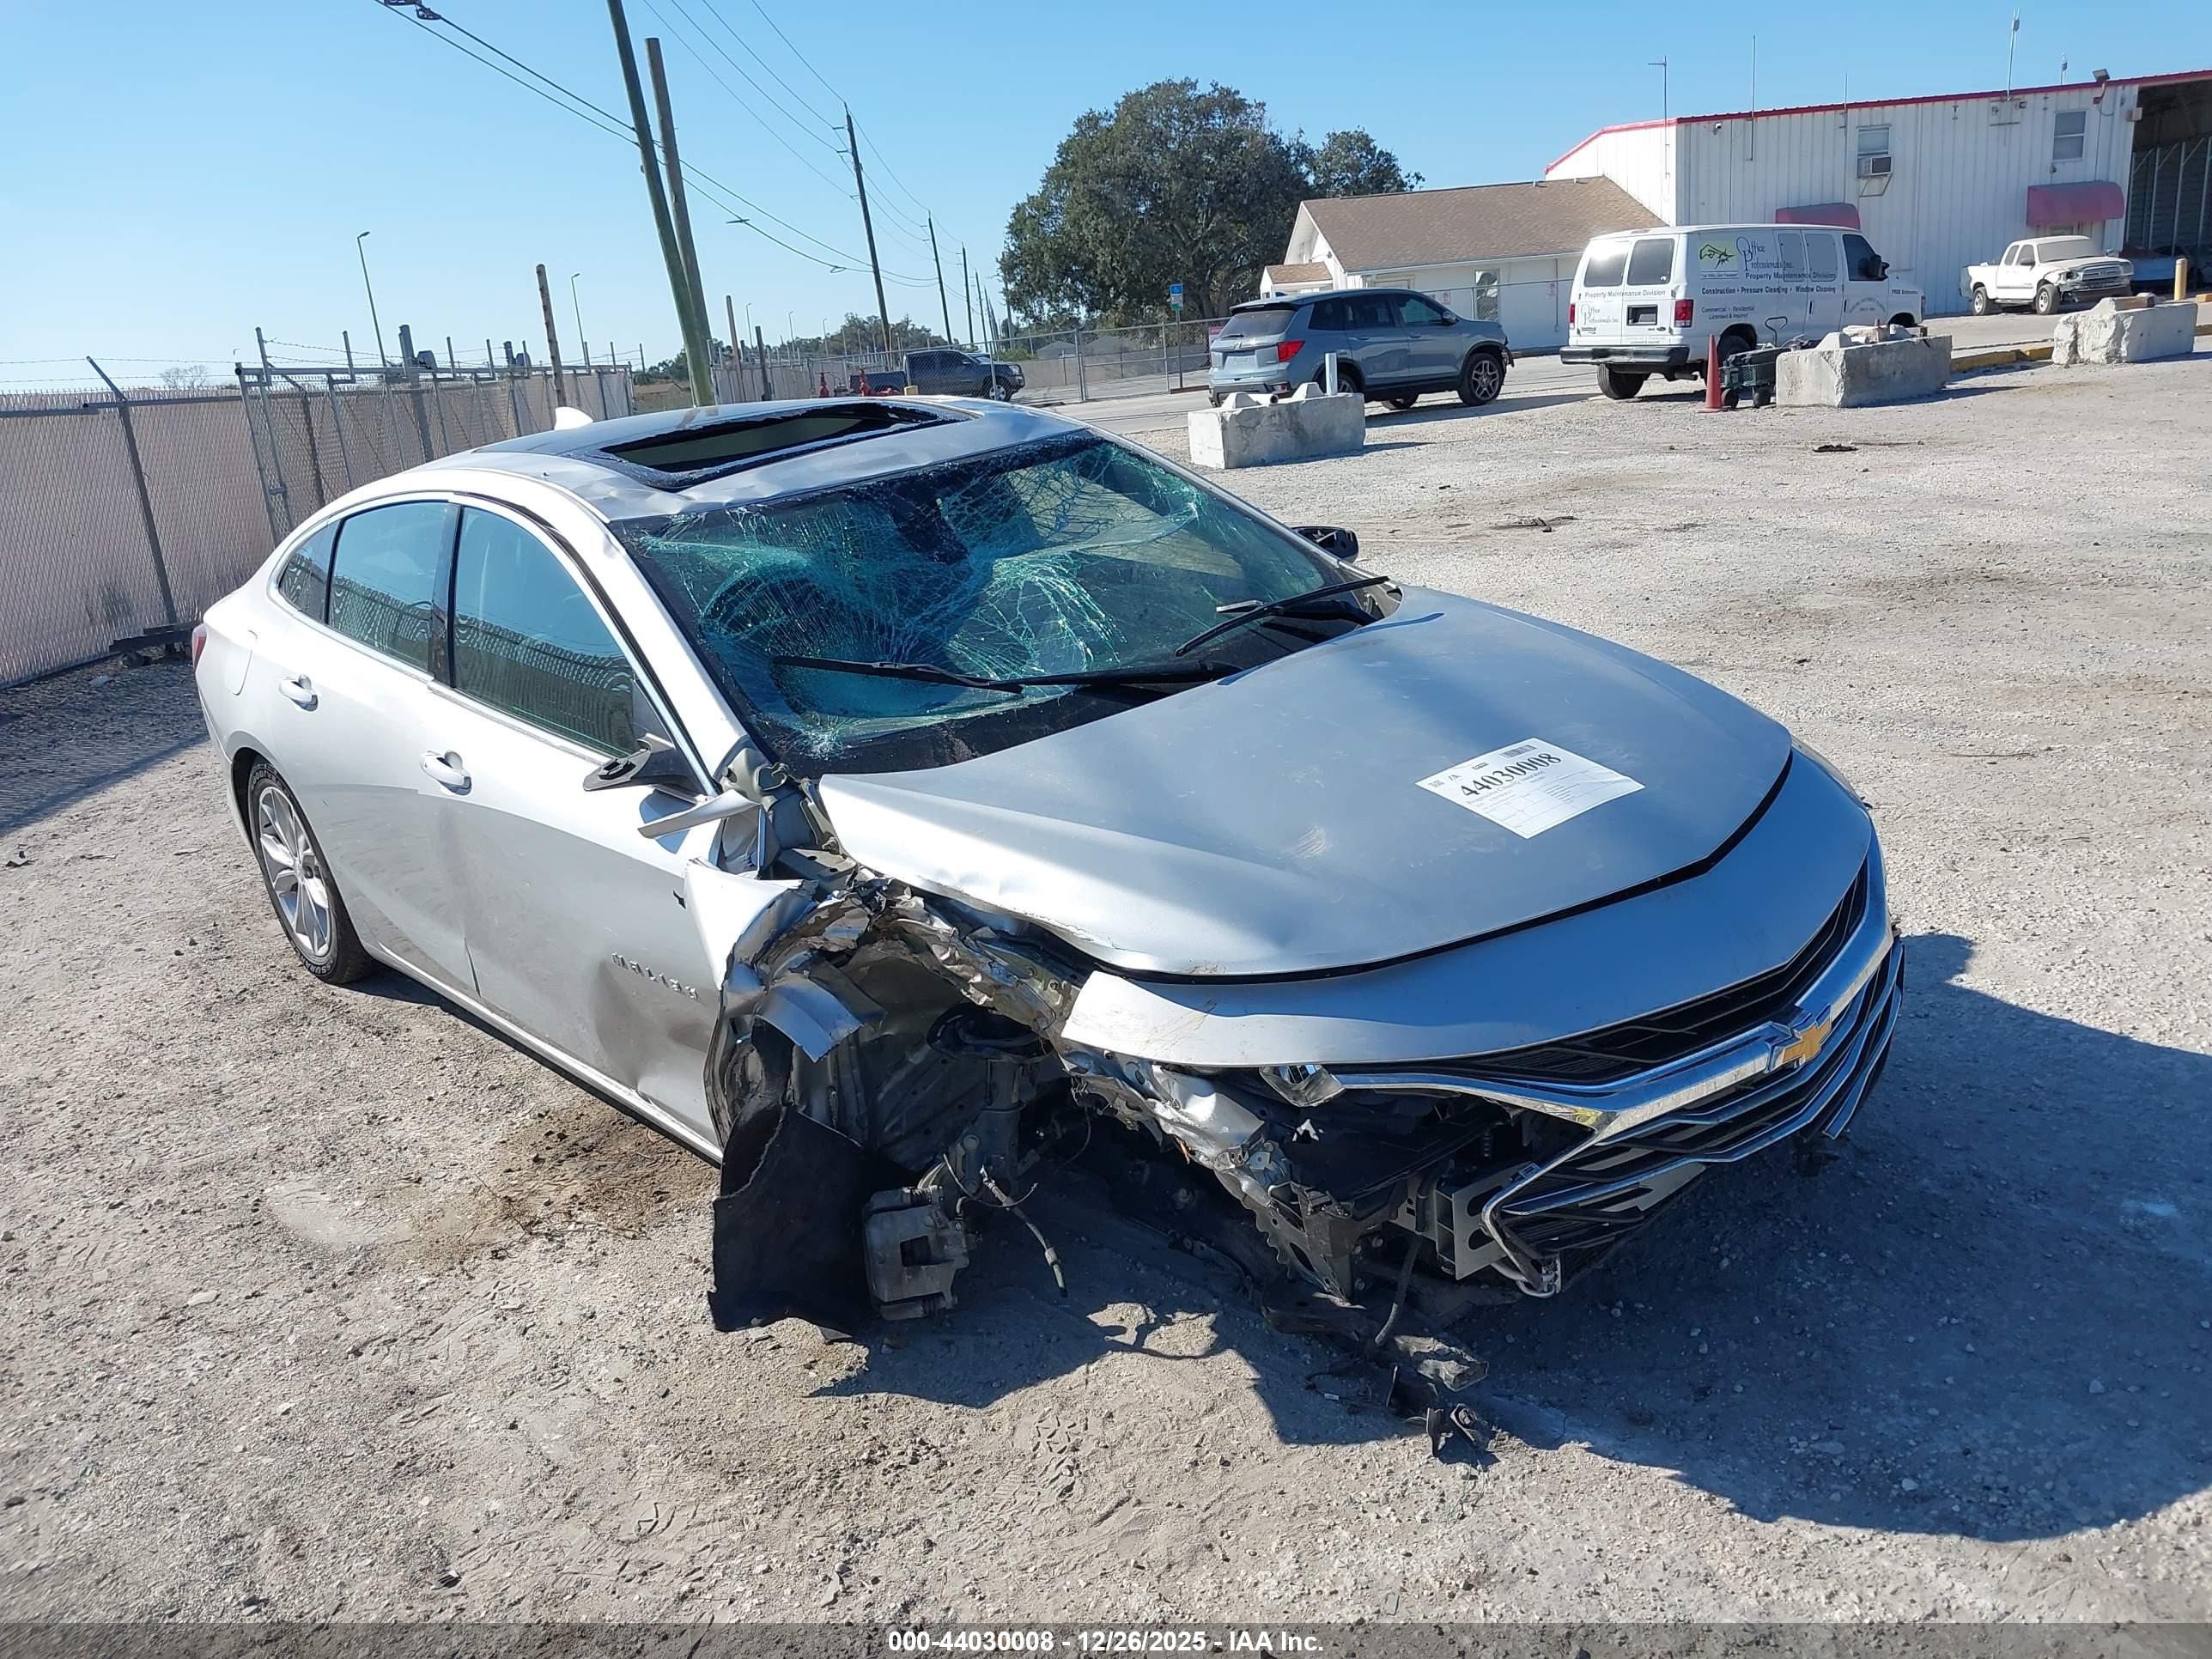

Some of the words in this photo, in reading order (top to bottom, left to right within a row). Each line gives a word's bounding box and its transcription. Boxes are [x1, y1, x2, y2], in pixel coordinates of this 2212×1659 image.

[1746, 271, 1772, 281] Property
[1765, 285, 1788, 294] Cleaning
[1816, 285, 1837, 294] Cleaning
[1462, 753, 1561, 796] 44030008
